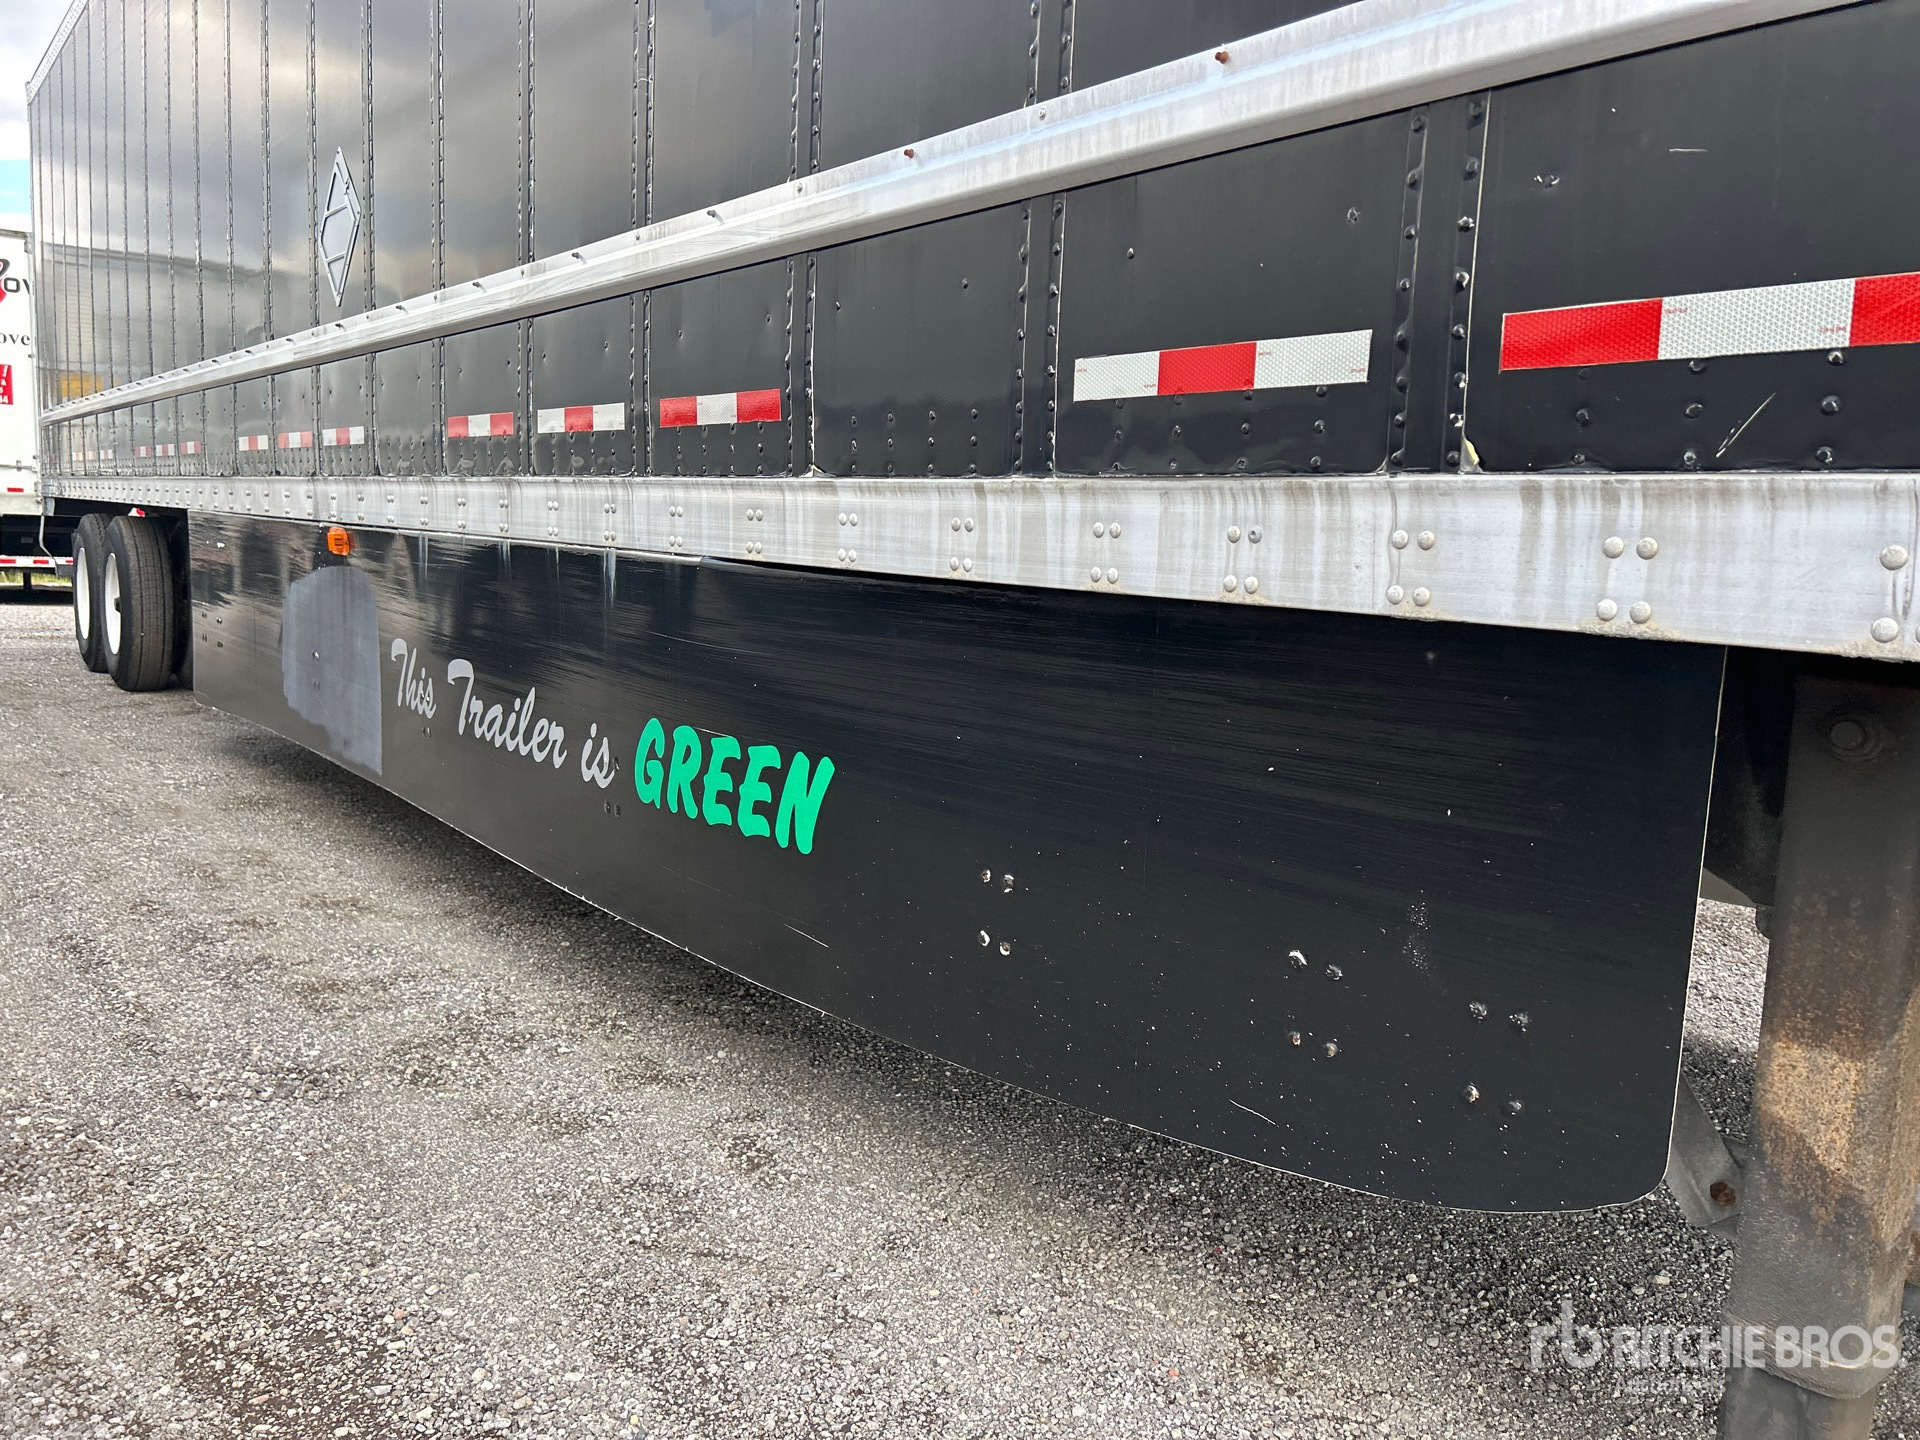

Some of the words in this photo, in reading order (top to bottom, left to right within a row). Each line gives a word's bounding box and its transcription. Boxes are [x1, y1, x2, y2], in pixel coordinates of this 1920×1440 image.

[391, 638, 436, 719] This
[447, 658, 567, 769] Trailer
[580, 723, 615, 788] is
[634, 718, 835, 855] GREEN
